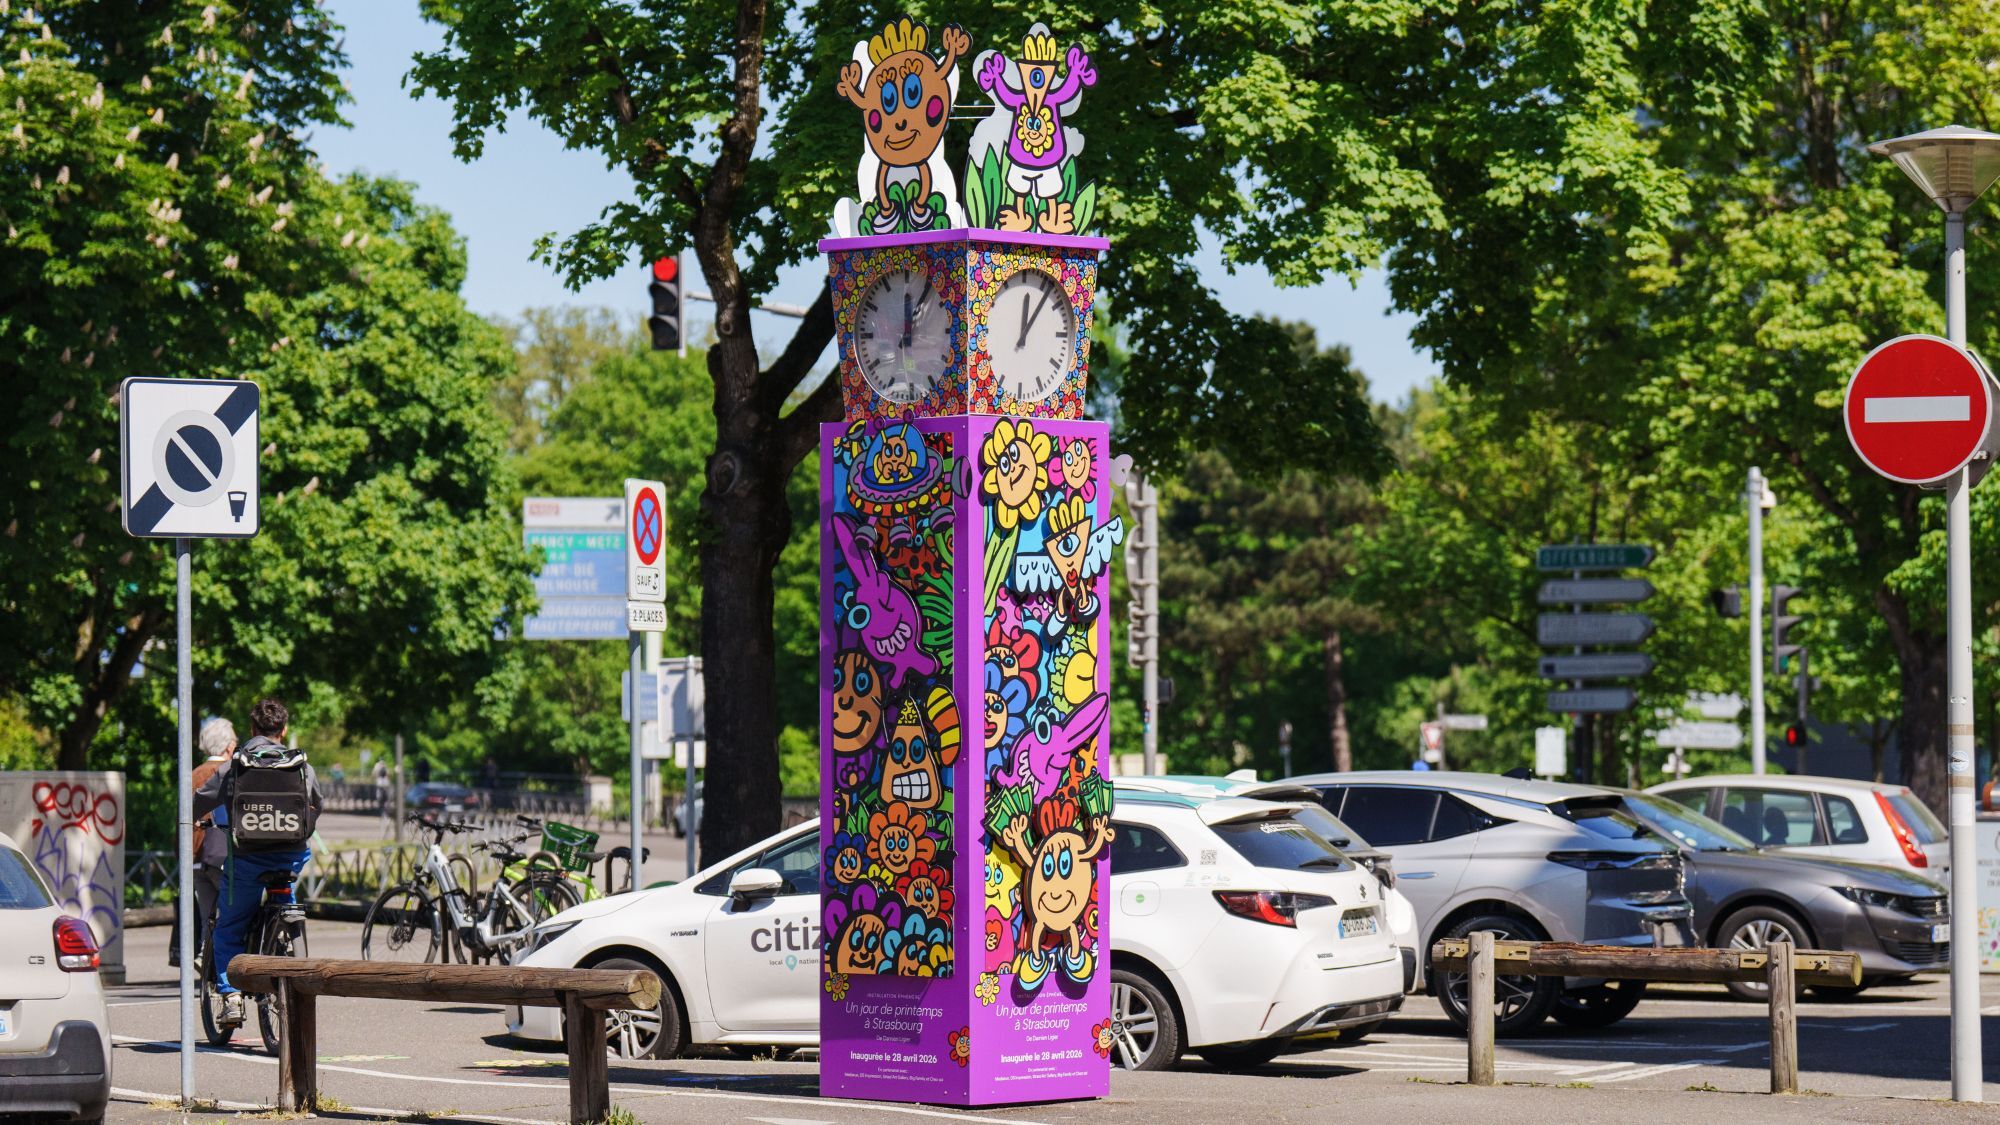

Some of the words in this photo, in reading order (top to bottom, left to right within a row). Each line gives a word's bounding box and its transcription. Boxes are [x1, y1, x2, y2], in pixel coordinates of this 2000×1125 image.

[1542, 549, 1626, 564] OFFENBURG
[637, 574, 651, 586] SAUF
[633, 610, 637, 621] 2
[639, 610, 663, 622] PLACES
[243, 804, 273, 812] UBER
[241, 810, 299, 832] eats
[28, 955, 45, 965] C3
[846, 1002, 859, 1014] Un
[859, 1003, 879, 1016] jour
[880, 1003, 893, 1015] de
[894, 1004, 943, 1019] printemps
[996, 1004, 1008, 1016] Un
[1009, 1006, 1028, 1018] jour
[1030, 1003, 1042, 1015] de
[1043, 1002, 1088, 1016] printemps
[864, 1018, 871, 1029] à
[872, 1018, 923, 1033] Strasbourg
[1014, 1019, 1021, 1030] à
[1022, 1017, 1070, 1030] Strasbourg
[850, 1050, 883, 1062] Inaugurée
[884, 1052, 891, 1061] le
[892, 1053, 902, 1062] 28
[902, 1054, 918, 1062] avril
[918, 1054, 937, 1064] 2026
[1001, 1052, 1033, 1064] Inaugurée
[1034, 1052, 1040, 1061] le
[1041, 1051, 1050, 1061] 28
[1051, 1050, 1065, 1060] avril
[1065, 1050, 1082, 1059] 2026
